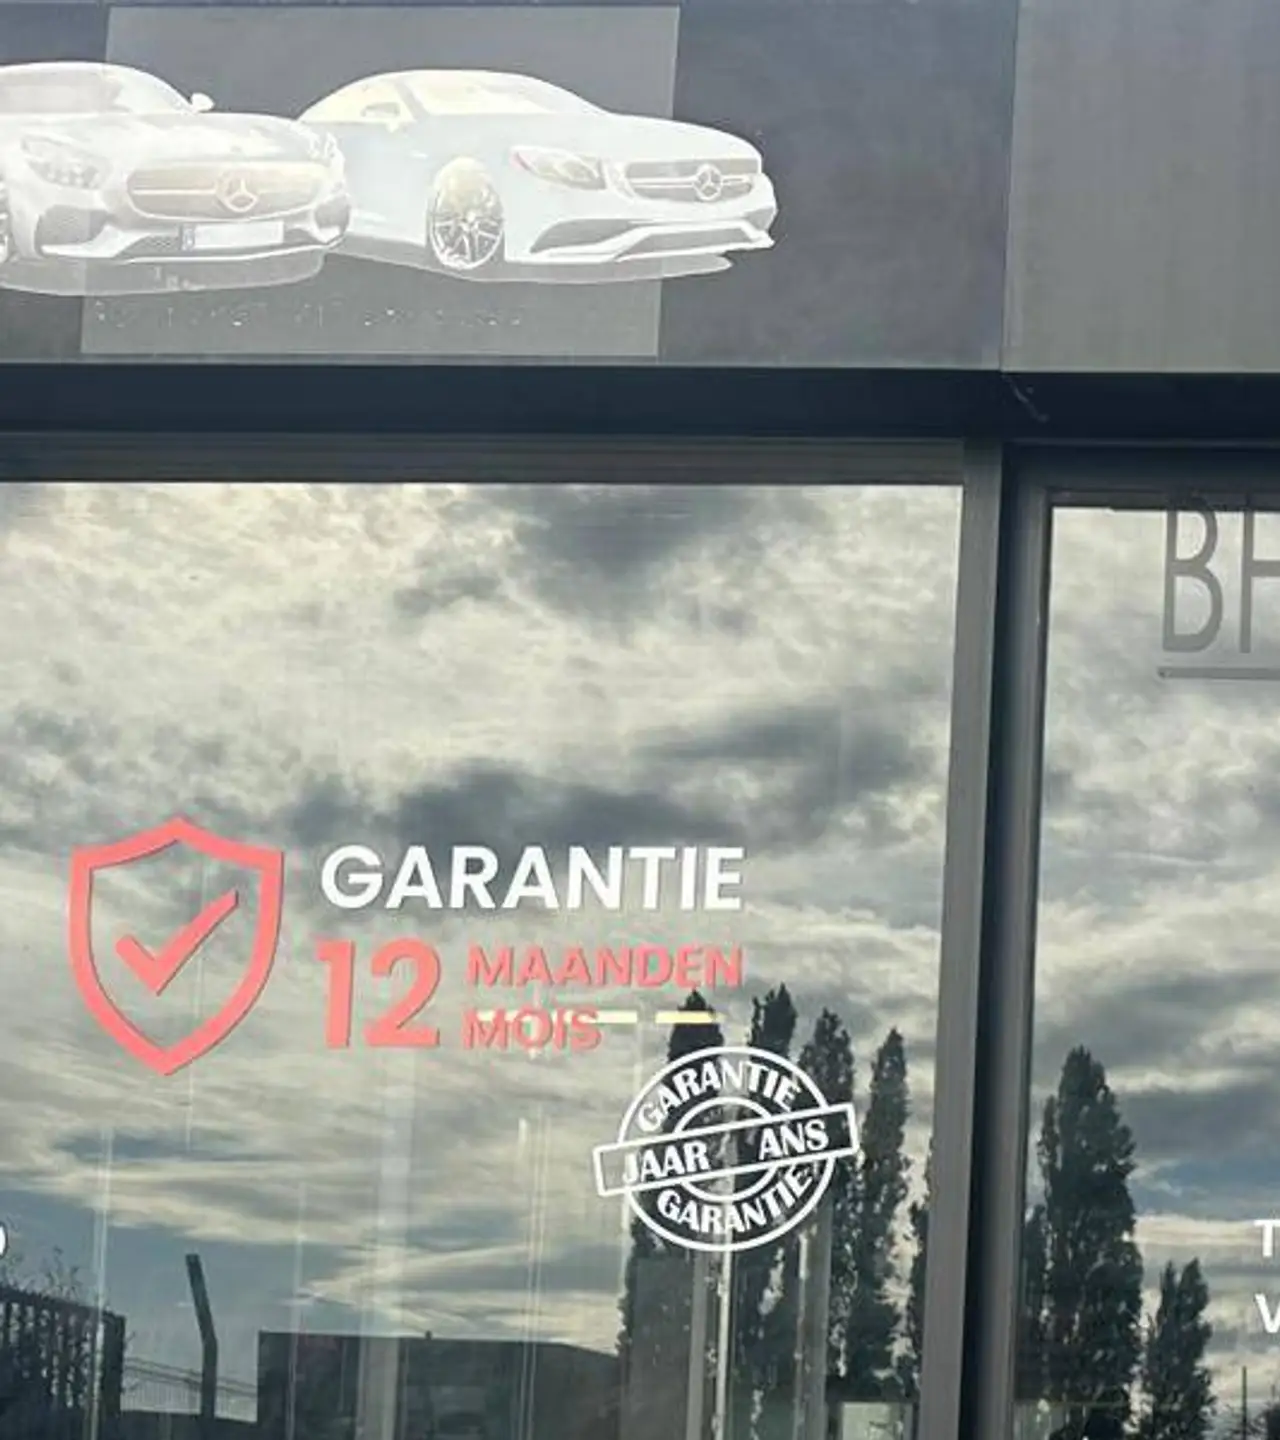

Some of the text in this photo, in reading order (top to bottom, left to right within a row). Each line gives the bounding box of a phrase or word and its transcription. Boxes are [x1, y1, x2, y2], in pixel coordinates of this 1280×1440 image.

[320, 844, 744, 912] GARANTIE
[315, 937, 442, 1050] 12
[464, 943, 744, 990] MAANDEN
[460, 1005, 604, 1052] MOIS
[637, 1057, 802, 1133] GARANTIE
[622, 1118, 830, 1184] JAAR ANS
[655, 1162, 814, 1235] GARANTIE
